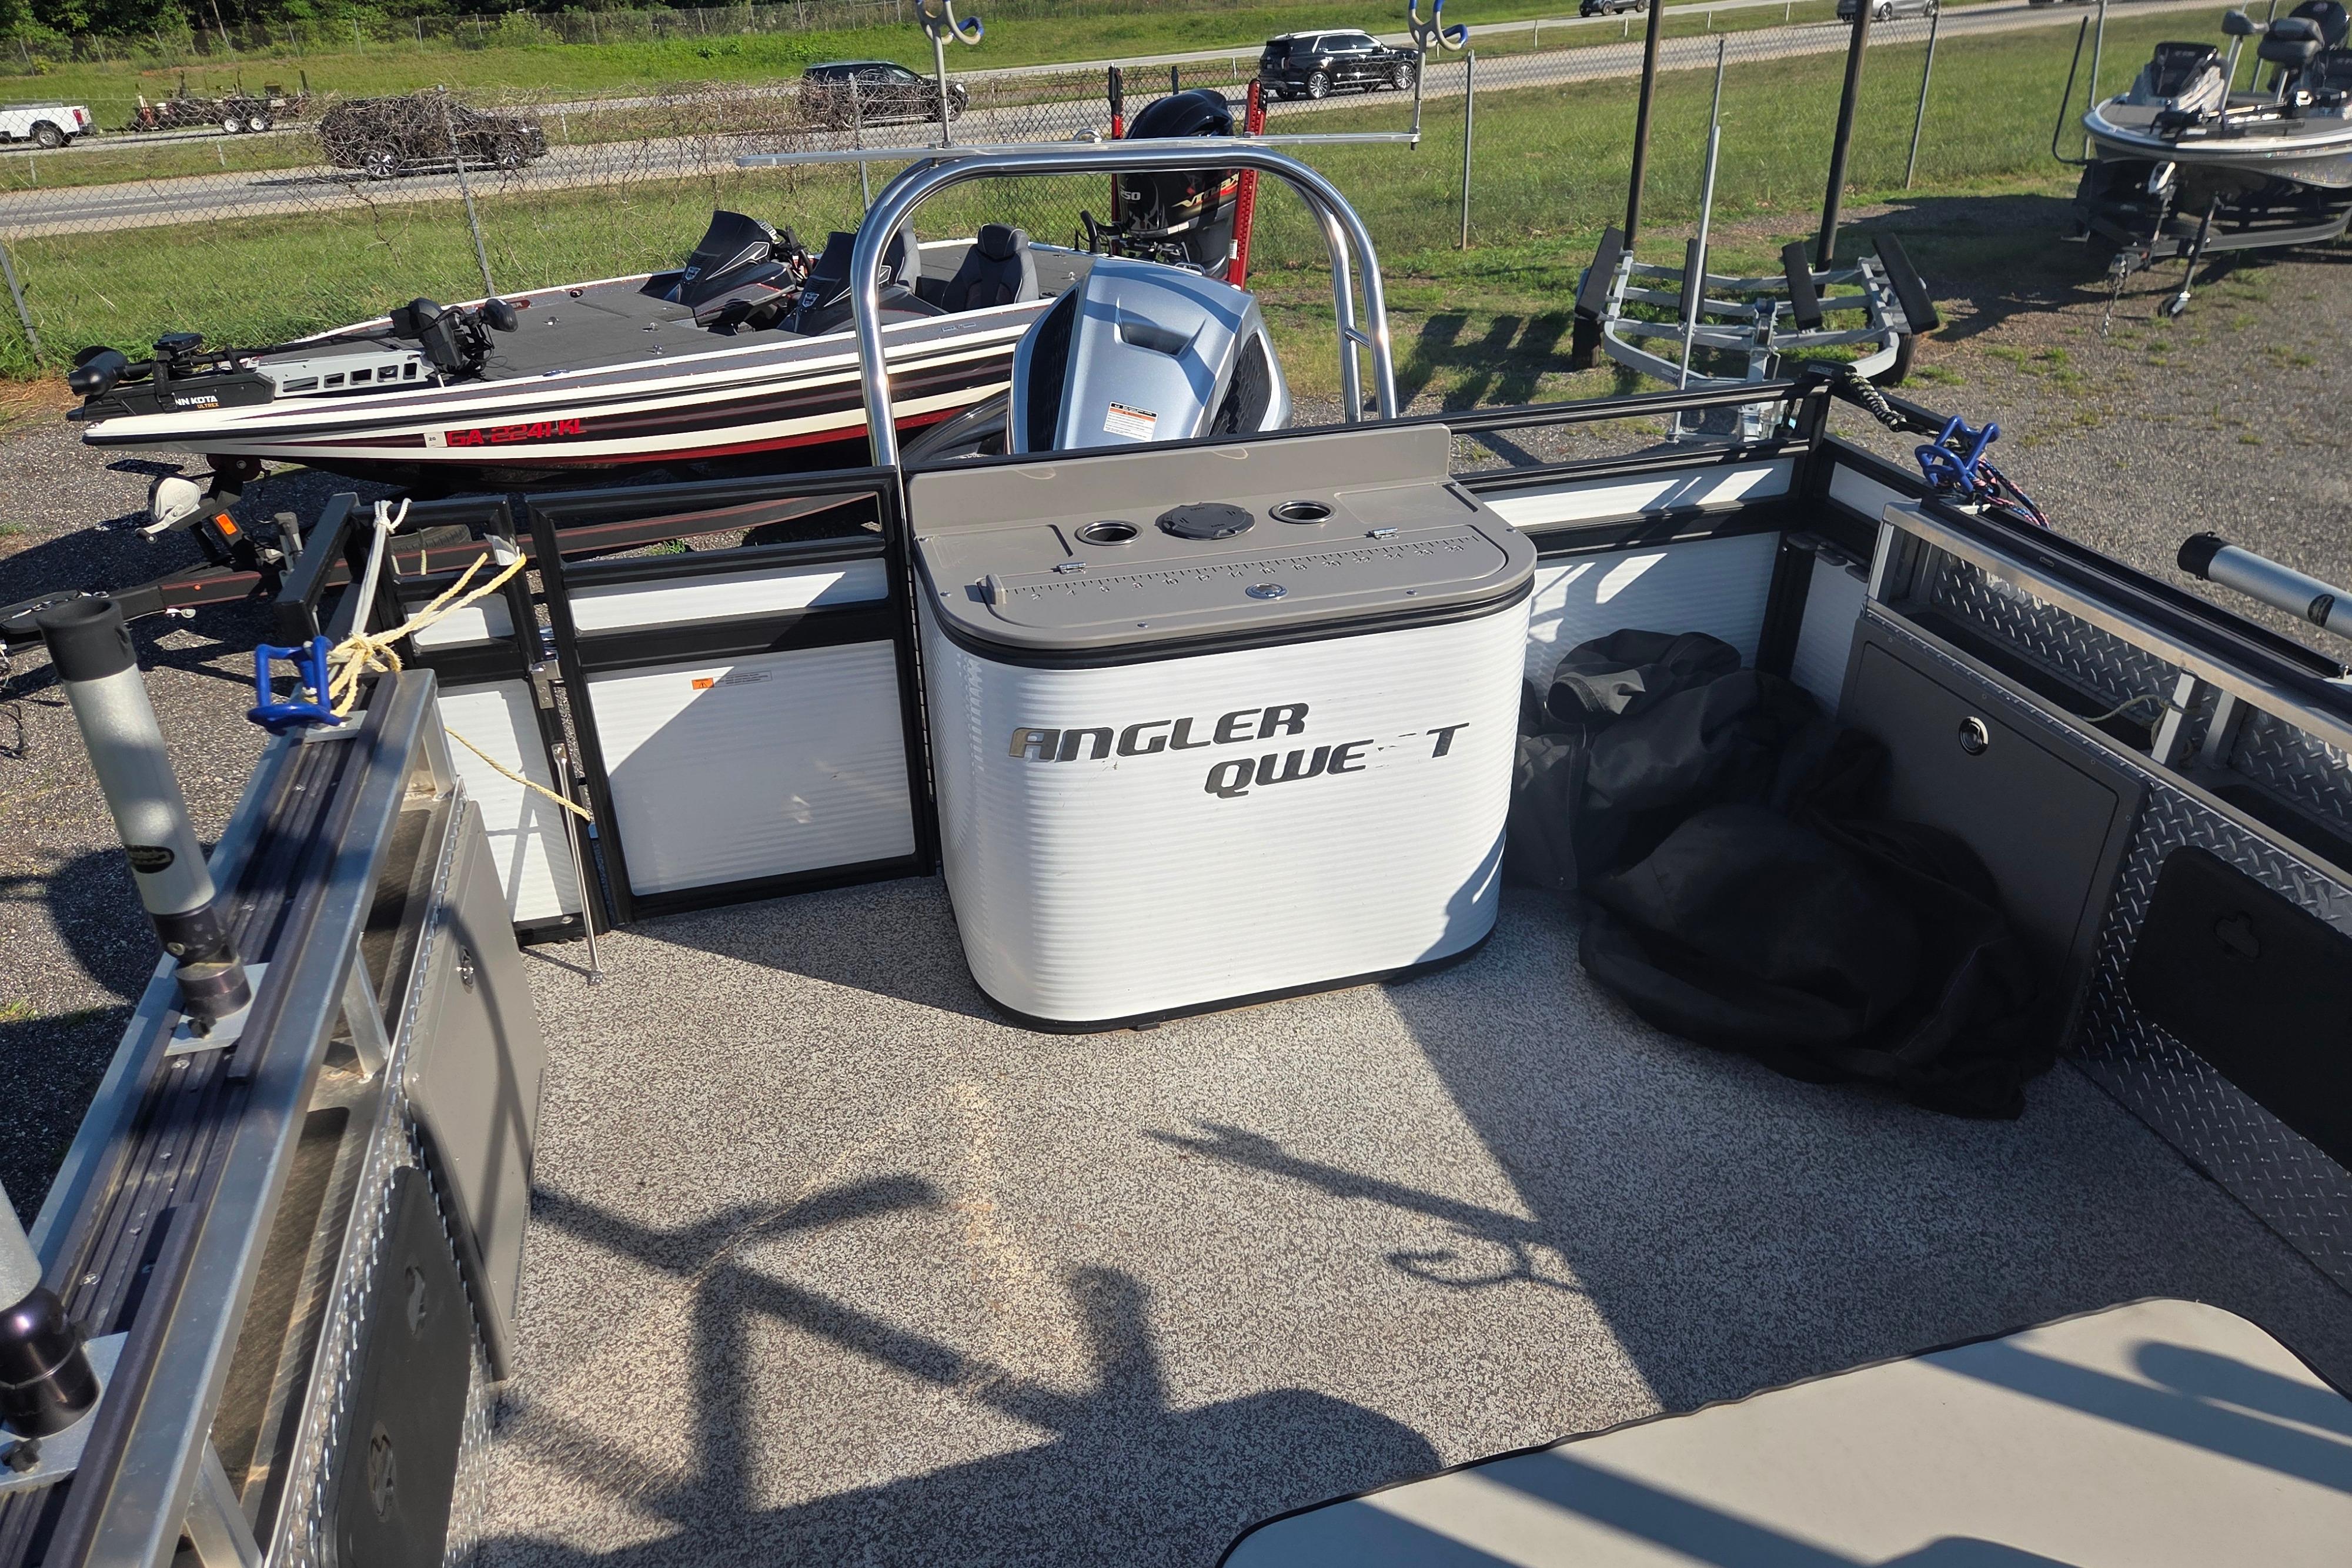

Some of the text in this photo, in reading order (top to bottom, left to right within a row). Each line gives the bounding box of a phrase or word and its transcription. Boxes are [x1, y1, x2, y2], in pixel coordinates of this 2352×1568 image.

[190, 395, 218, 404] KOTA
[446, 418, 587, 446] GA 2241 KL
[1008, 703, 1309, 763] ANGLER
[1204, 723, 1469, 799] QWET
